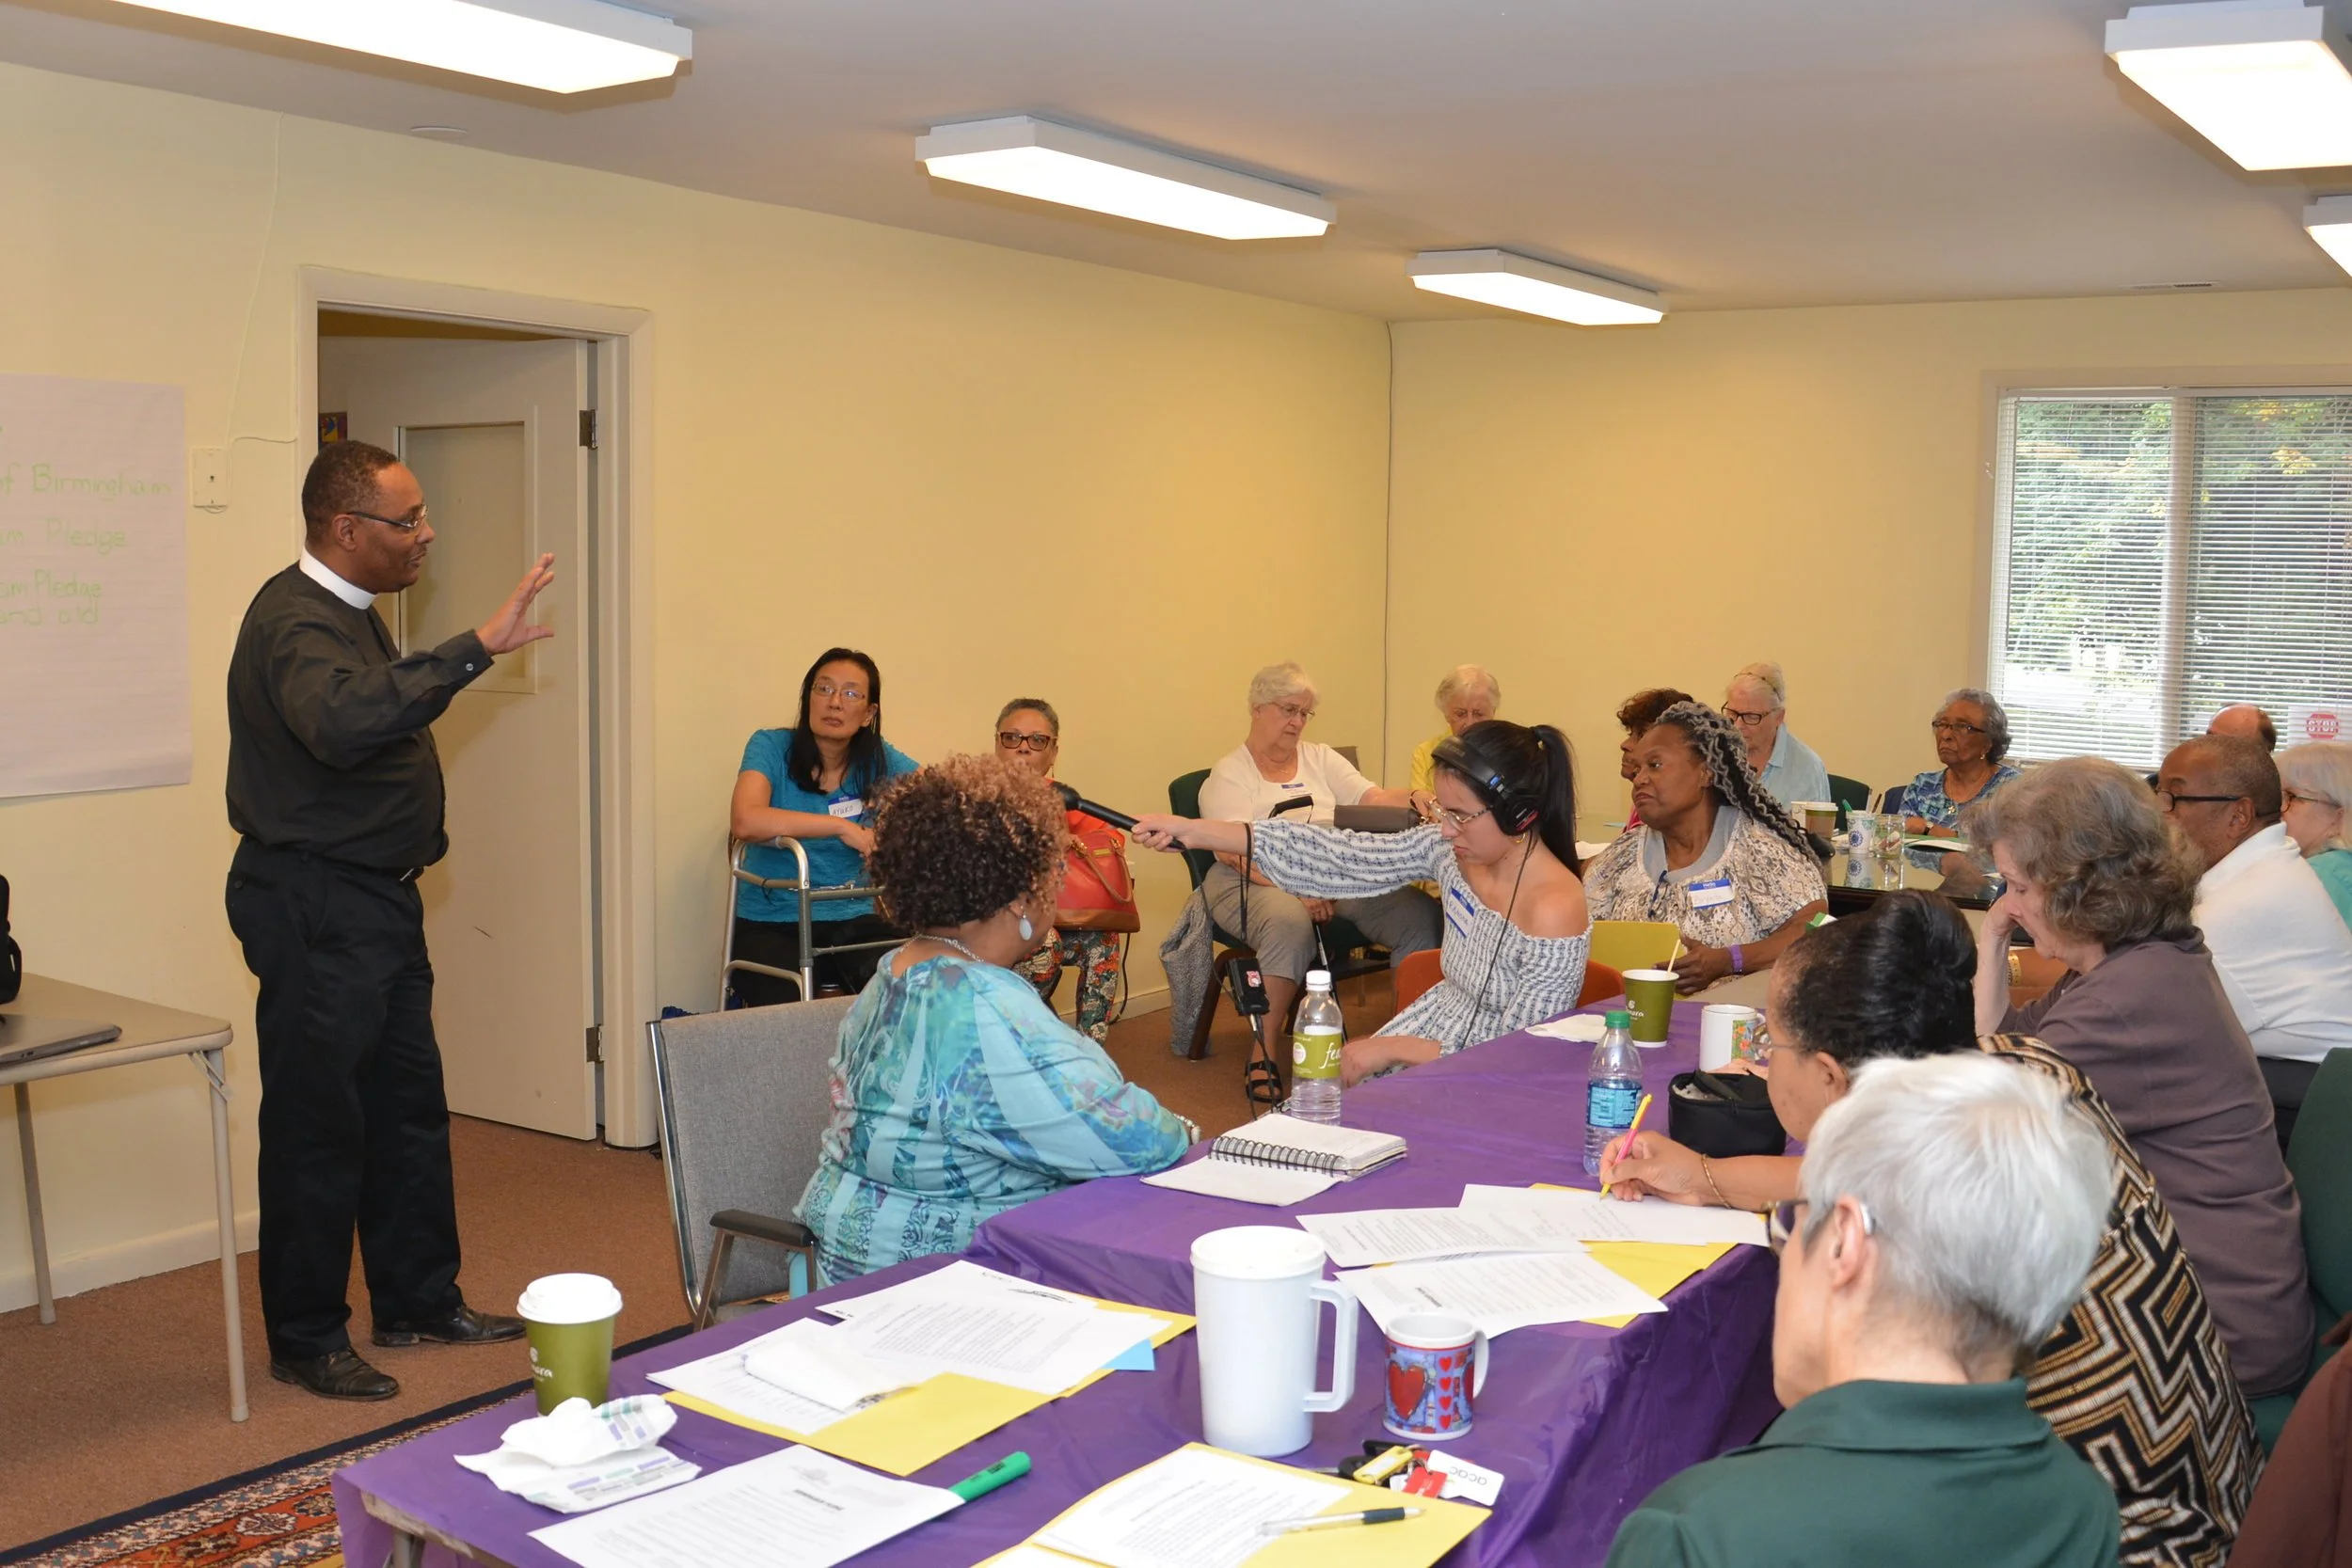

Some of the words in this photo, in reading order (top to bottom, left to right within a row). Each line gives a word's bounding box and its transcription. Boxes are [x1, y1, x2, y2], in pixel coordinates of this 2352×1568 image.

[32, 463, 171, 501] Birmingham
[46, 517, 127, 555] Pledge
[34, 568, 103, 602] Pledge
[57, 598, 99, 626] old
[2308, 720, 2336, 732] STOP
